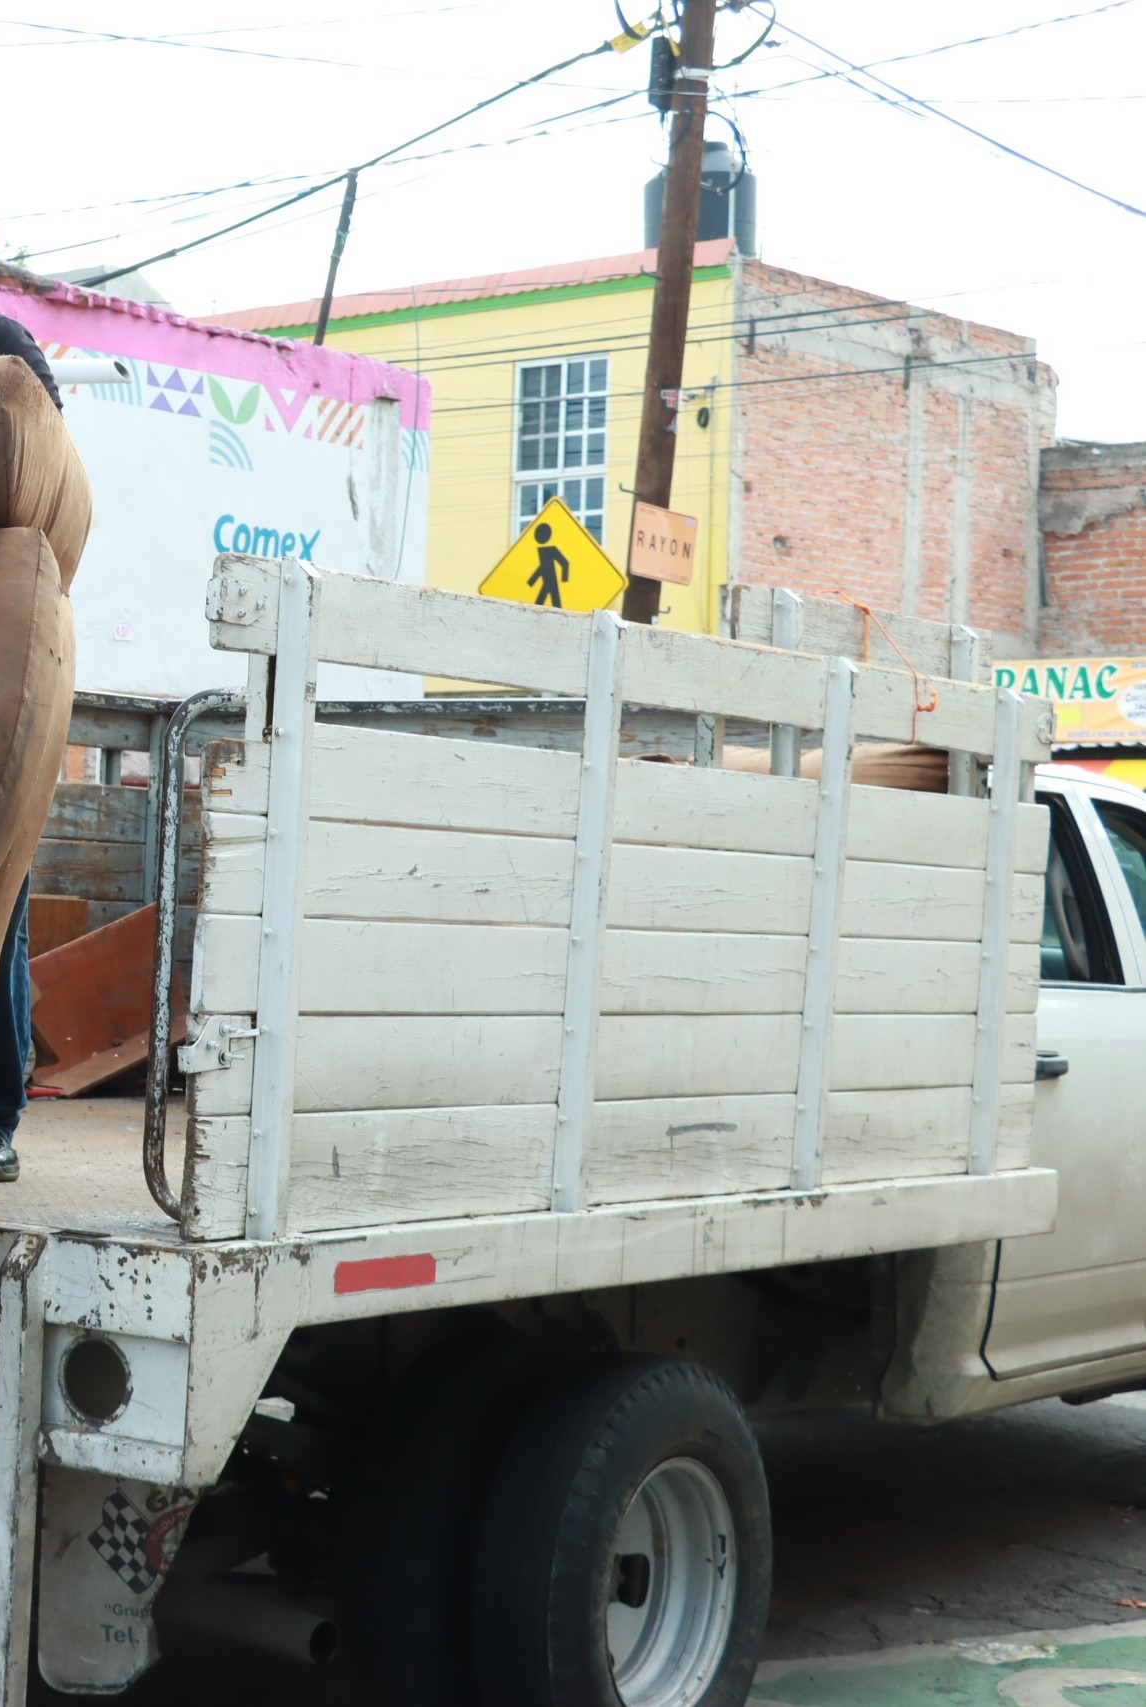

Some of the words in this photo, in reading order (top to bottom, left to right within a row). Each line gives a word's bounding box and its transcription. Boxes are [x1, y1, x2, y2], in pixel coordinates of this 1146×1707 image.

[214, 514, 320, 561] Comex
[636, 529, 691, 559] RAYON
[105, 1603, 153, 1619] "Grup
[100, 1624, 140, 1644] Tel.
